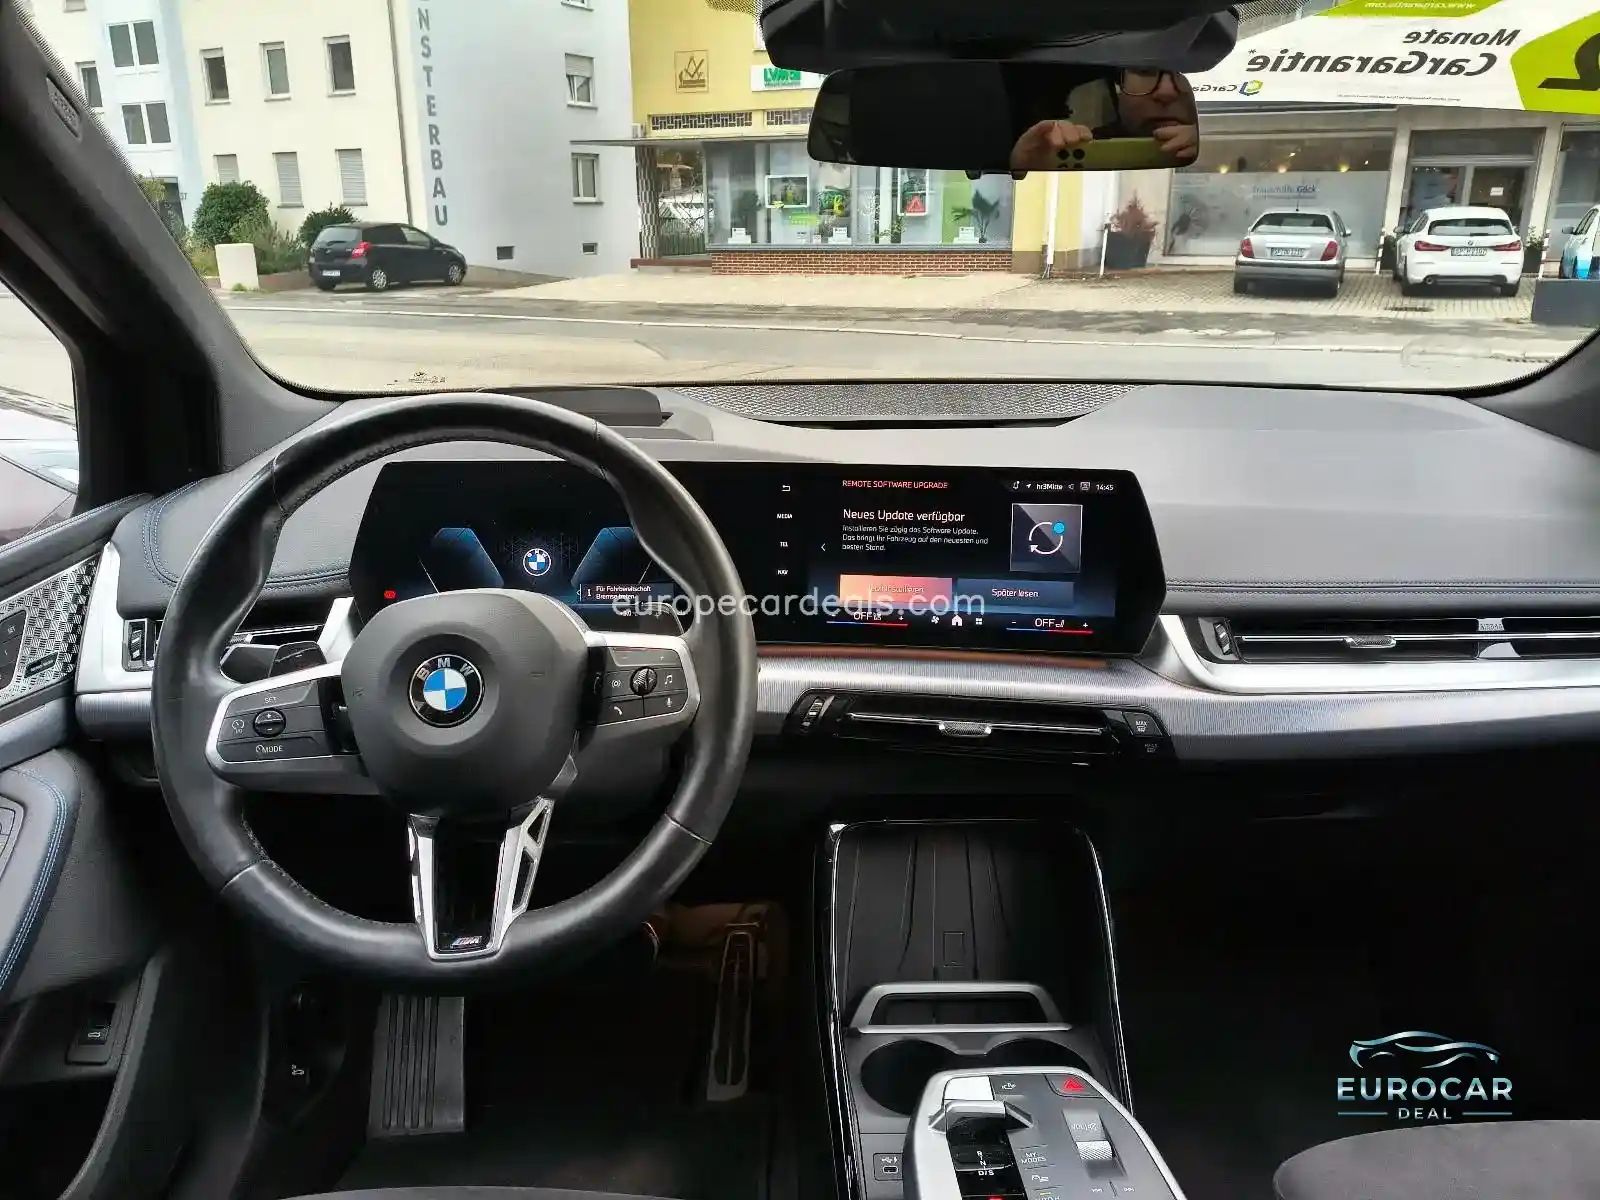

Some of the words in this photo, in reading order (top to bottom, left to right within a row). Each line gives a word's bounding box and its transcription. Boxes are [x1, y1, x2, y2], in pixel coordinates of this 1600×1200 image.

[417, 0, 448, 226] NSTERBAU
[842, 480, 872, 488] REMOTE
[873, 480, 912, 489] SOFTWARE
[913, 481, 949, 489] UPGRADE
[843, 509, 875, 519] Neues
[877, 510, 914, 521] Update
[916, 510, 966, 523] verfügbar
[878, 525, 889, 533] Sie
[890, 525, 908, 534] zügig
[909, 526, 921, 534] das
[922, 526, 952, 534] Software
[842, 533, 856, 541] Das
[856, 534, 876, 542] bringt
[886, 535, 917, 544] Fahrzeug
[917, 535, 928, 543] auf
[929, 536, 941, 544] den
[975, 536, 989, 545] und
[842, 543, 864, 551] besten
[991, 588, 1018, 598] Später
[1018, 588, 1039, 597] lesen
[853, 611, 873, 621] OFF
[1034, 618, 1056, 628] OFF
[416, 657, 475, 682] BMW
[264, 696, 278, 704] SET
[262, 746, 284, 755] MODE
